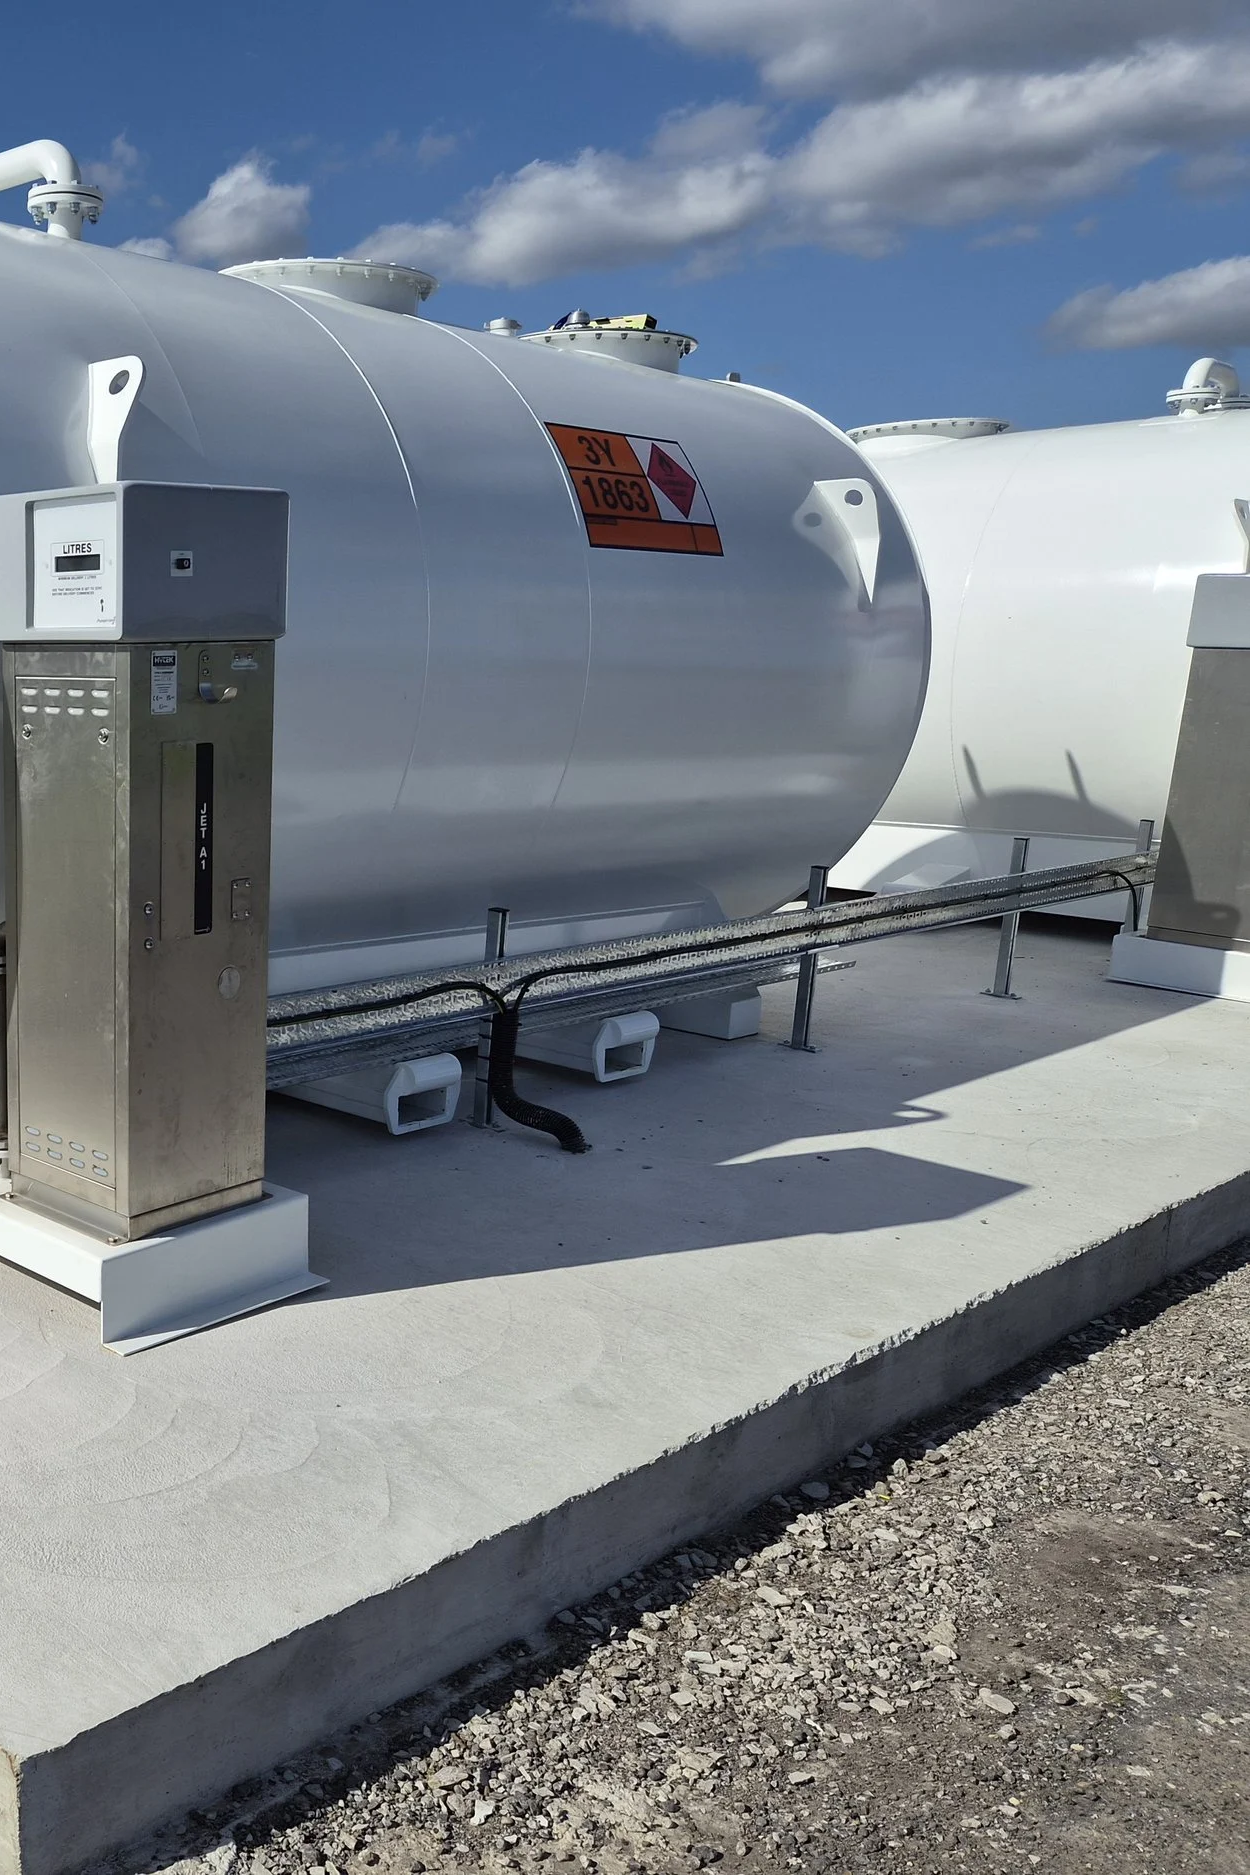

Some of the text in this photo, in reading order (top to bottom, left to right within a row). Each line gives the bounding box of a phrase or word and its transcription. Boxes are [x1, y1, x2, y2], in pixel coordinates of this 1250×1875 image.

[577, 435, 616, 467] 3Y
[582, 475, 650, 513] 1863
[63, 543, 92, 554] LITRES
[200, 847, 207, 870] A1
